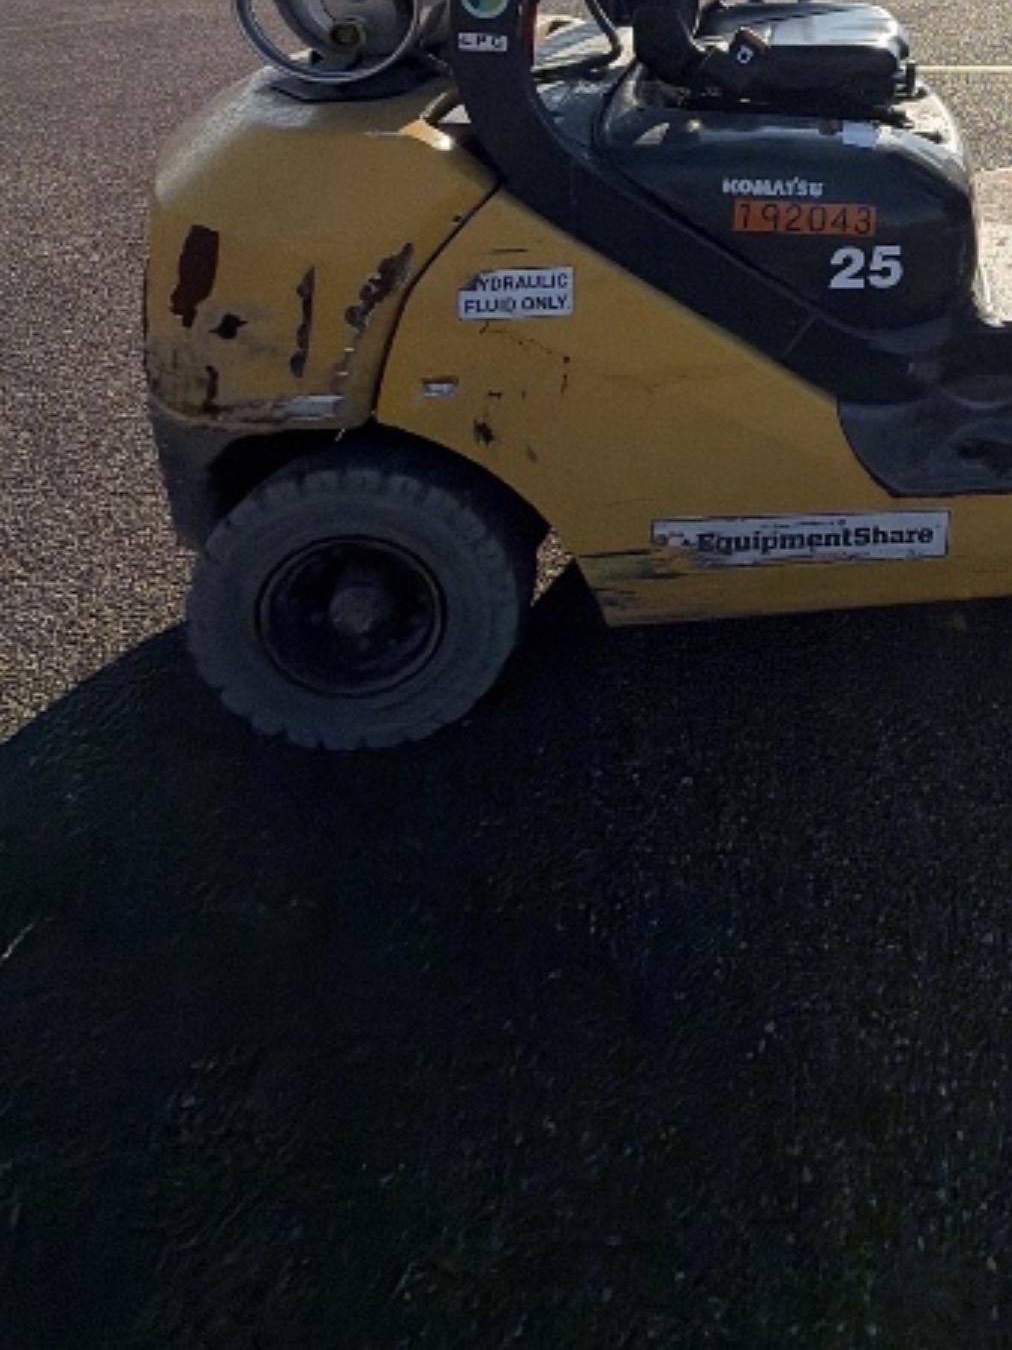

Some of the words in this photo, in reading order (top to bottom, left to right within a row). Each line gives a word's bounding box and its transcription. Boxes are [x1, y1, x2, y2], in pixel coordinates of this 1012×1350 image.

[722, 177, 824, 197] KOMATSU
[828, 245, 904, 289] 25
[475, 272, 568, 291] YDRAULIC
[697, 526, 933, 554] EquipmentShare
